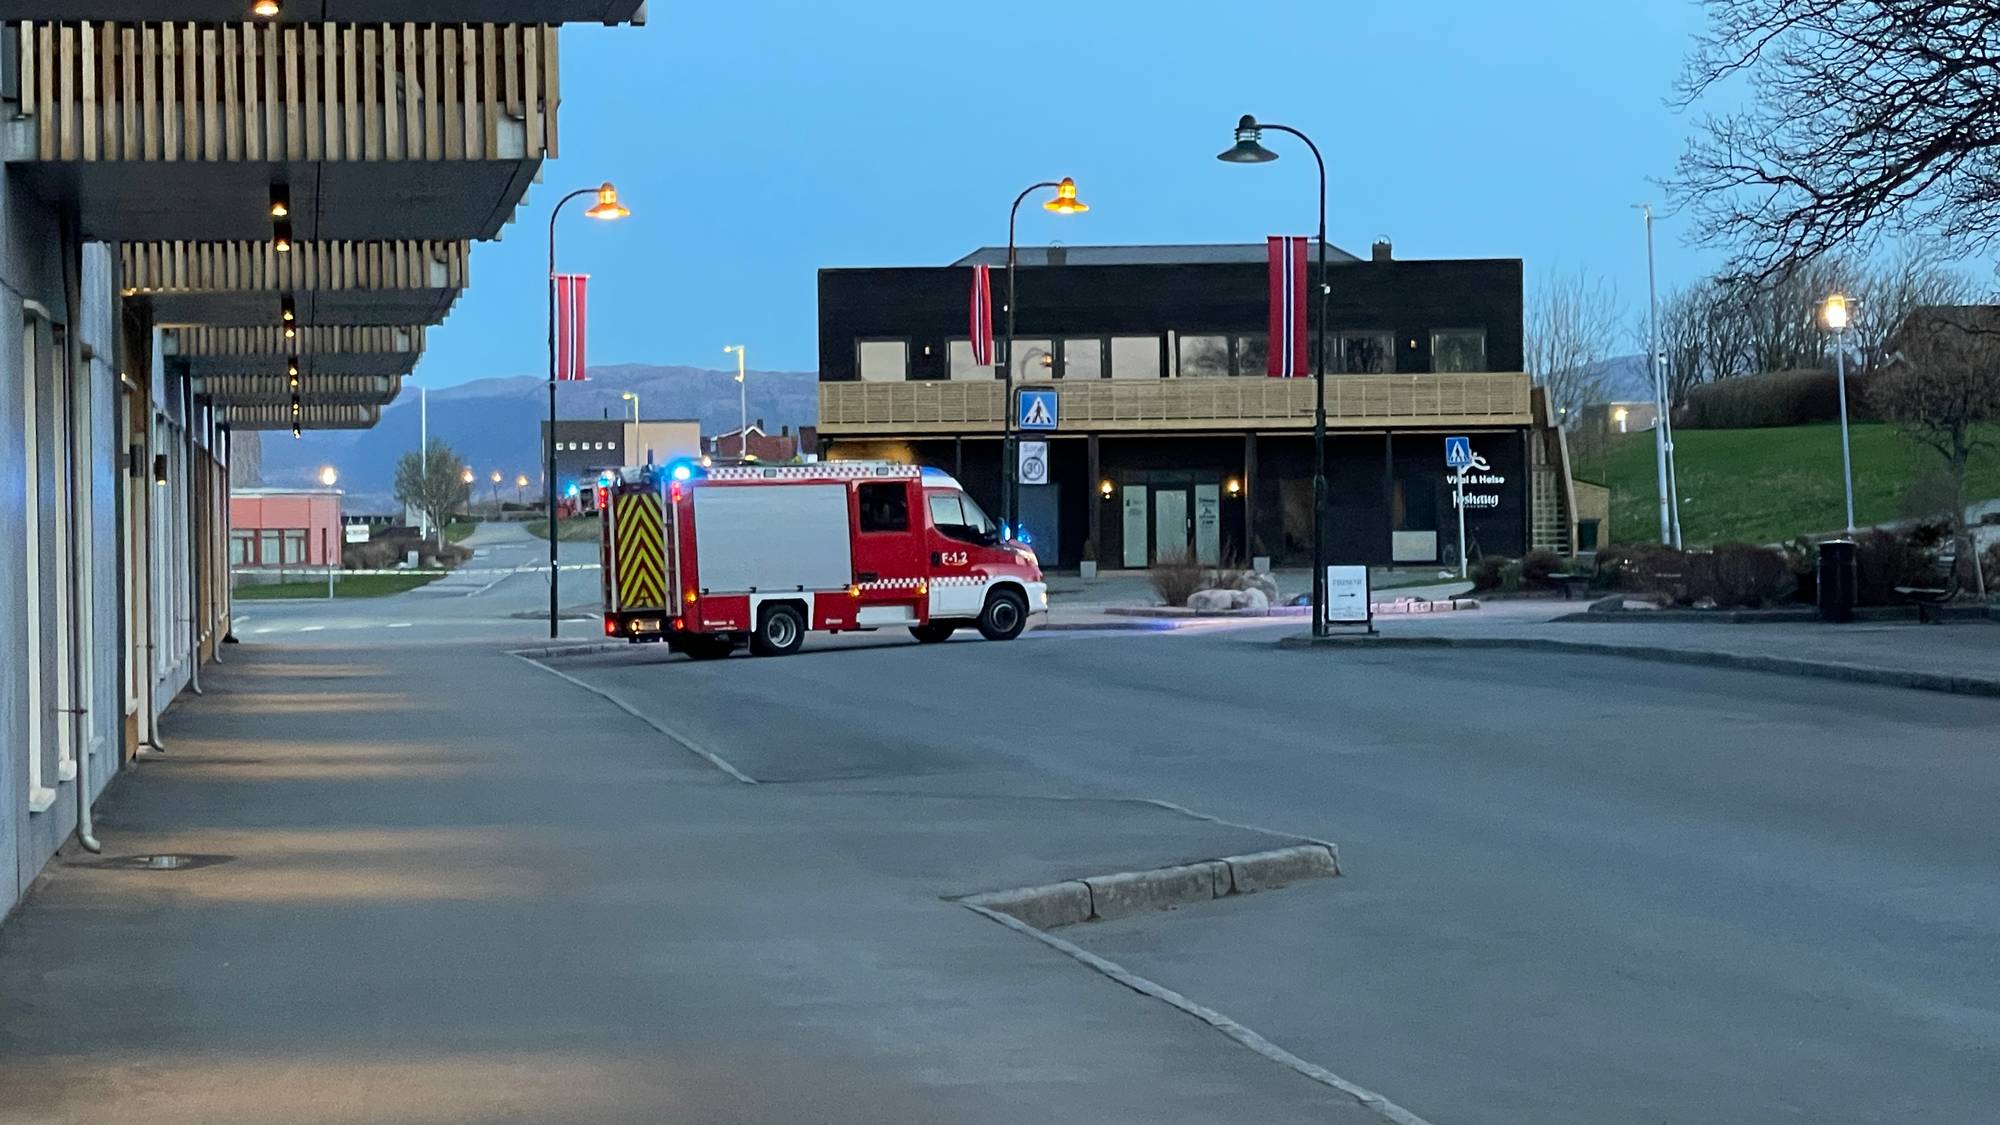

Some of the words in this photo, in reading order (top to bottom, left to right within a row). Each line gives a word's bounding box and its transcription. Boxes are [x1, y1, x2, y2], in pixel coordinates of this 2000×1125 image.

[1026, 462, 1041, 475] 30
[1446, 475, 1469, 484] Vial
[1470, 475, 1478, 484] &
[1479, 475, 1505, 484] Helse
